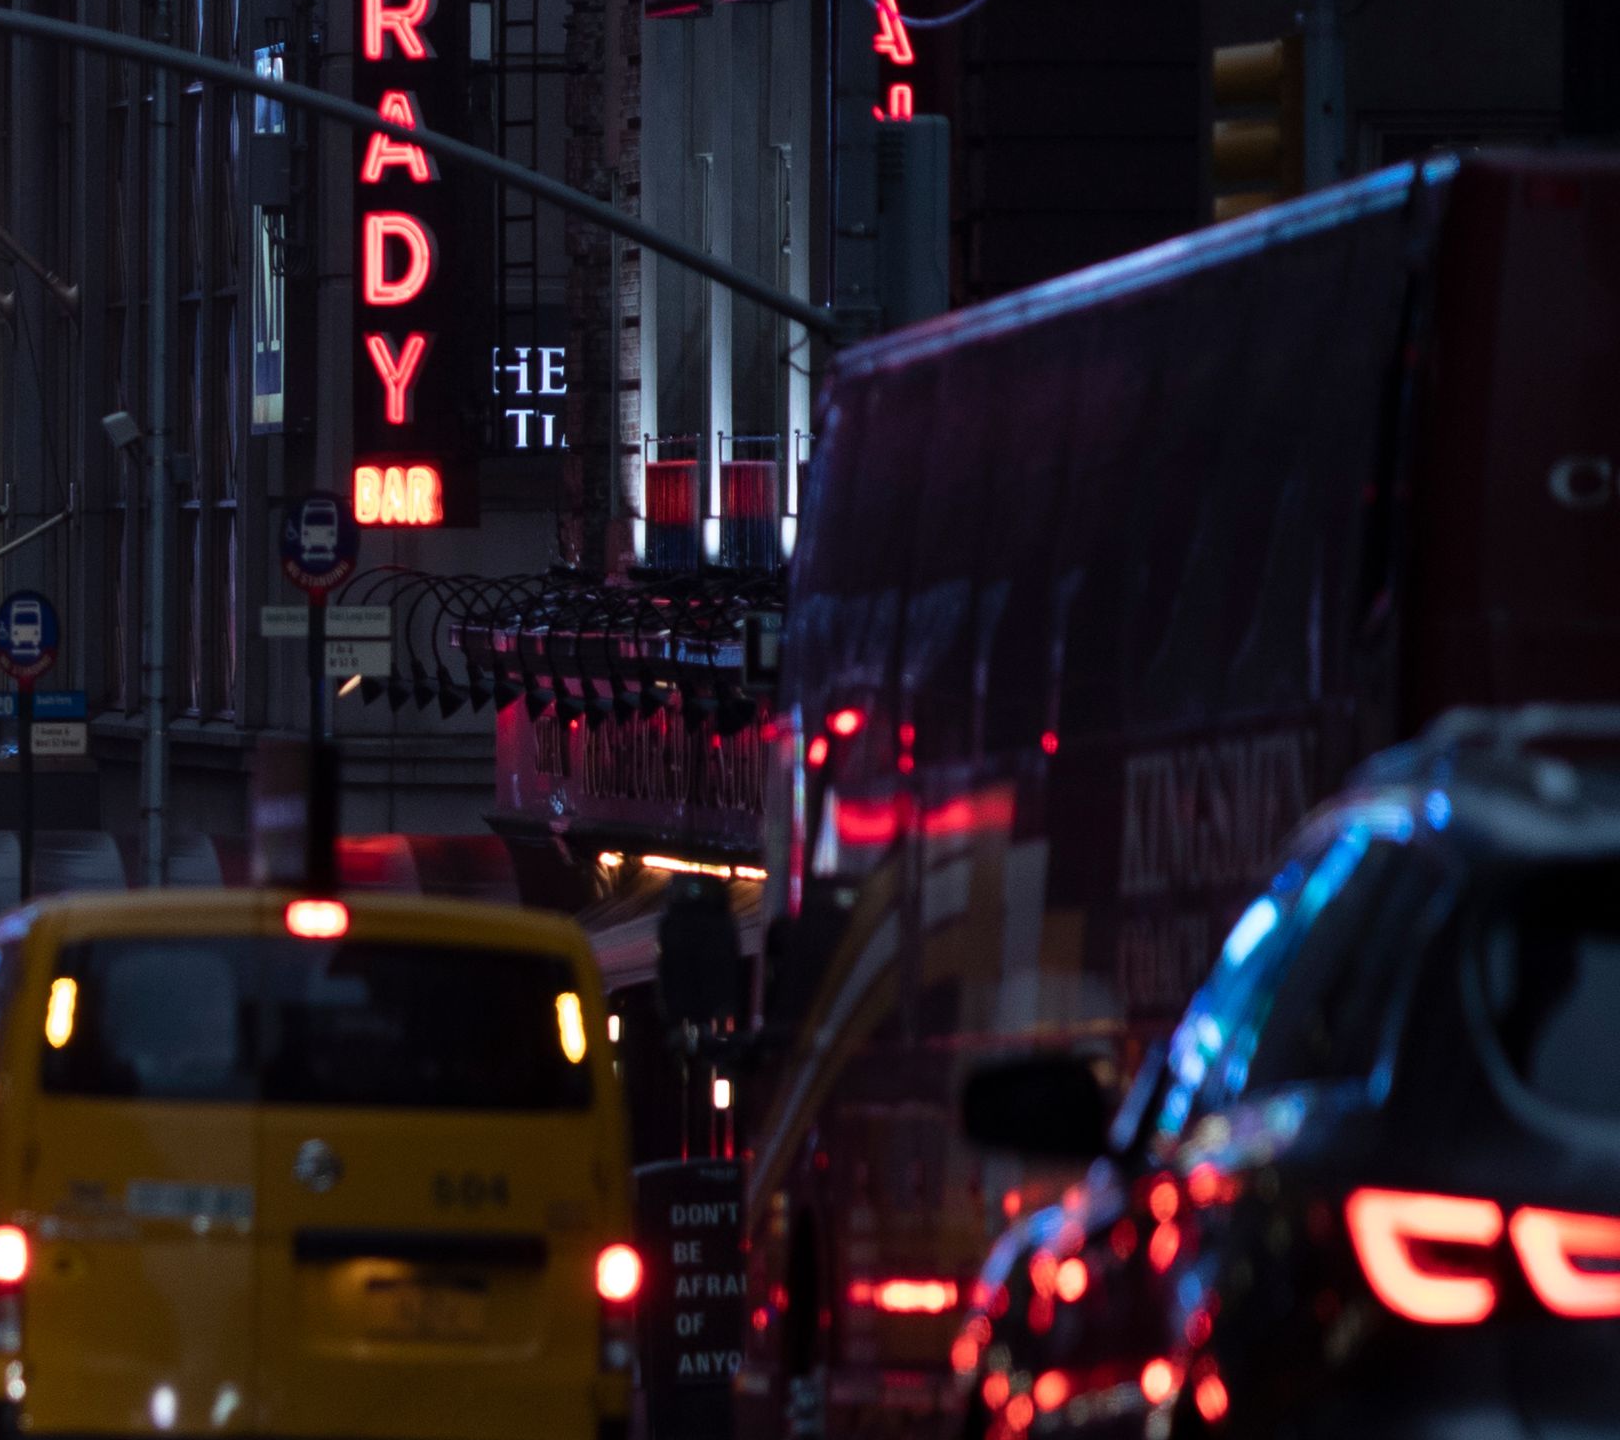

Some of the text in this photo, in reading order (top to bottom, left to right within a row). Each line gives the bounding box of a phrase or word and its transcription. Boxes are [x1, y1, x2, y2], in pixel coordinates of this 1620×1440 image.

[493, 347, 568, 395] HE
[353, 465, 443, 526] BAR
[670, 1201, 740, 1227] DON'T
[672, 1240, 702, 1265] BE
[675, 1273, 748, 1298] AFRAI
[675, 1312, 706, 1337] OF
[677, 1351, 743, 1376] ANYO
